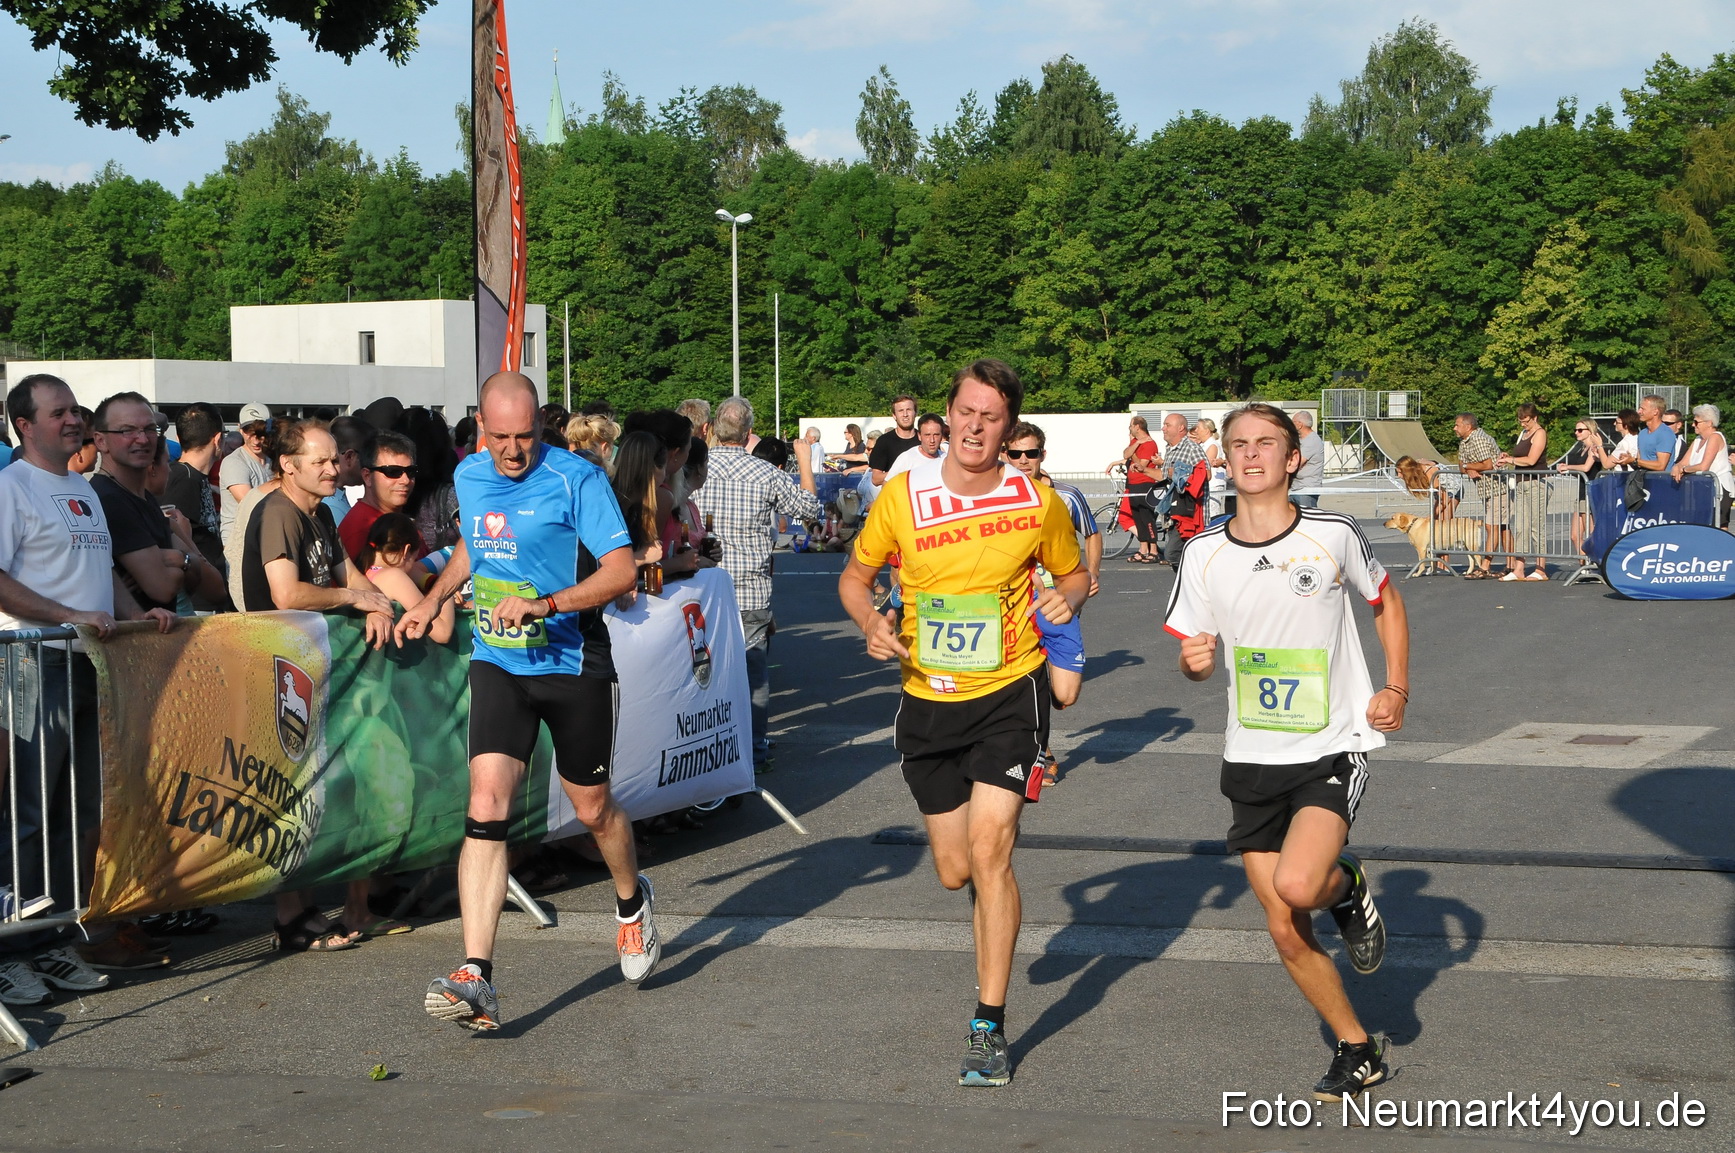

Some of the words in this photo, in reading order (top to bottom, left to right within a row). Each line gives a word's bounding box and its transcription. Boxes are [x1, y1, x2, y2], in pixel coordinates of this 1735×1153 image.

[472, 516, 482, 538] I
[915, 526, 972, 552] MAX
[979, 515, 1042, 538] BÖGL
[473, 537, 517, 554] camping
[1252, 564, 1275, 573] adidas
[1642, 557, 1733, 575] Fischer
[1650, 574, 1726, 584] AUTOMOBILE
[927, 620, 986, 652] 757
[1258, 677, 1300, 711] 87
[675, 698, 732, 740] Neumarkter
[284, 731, 302, 754] 1628
[657, 726, 741, 788] Lammsbräu
[166, 771, 308, 881] Lammsb
